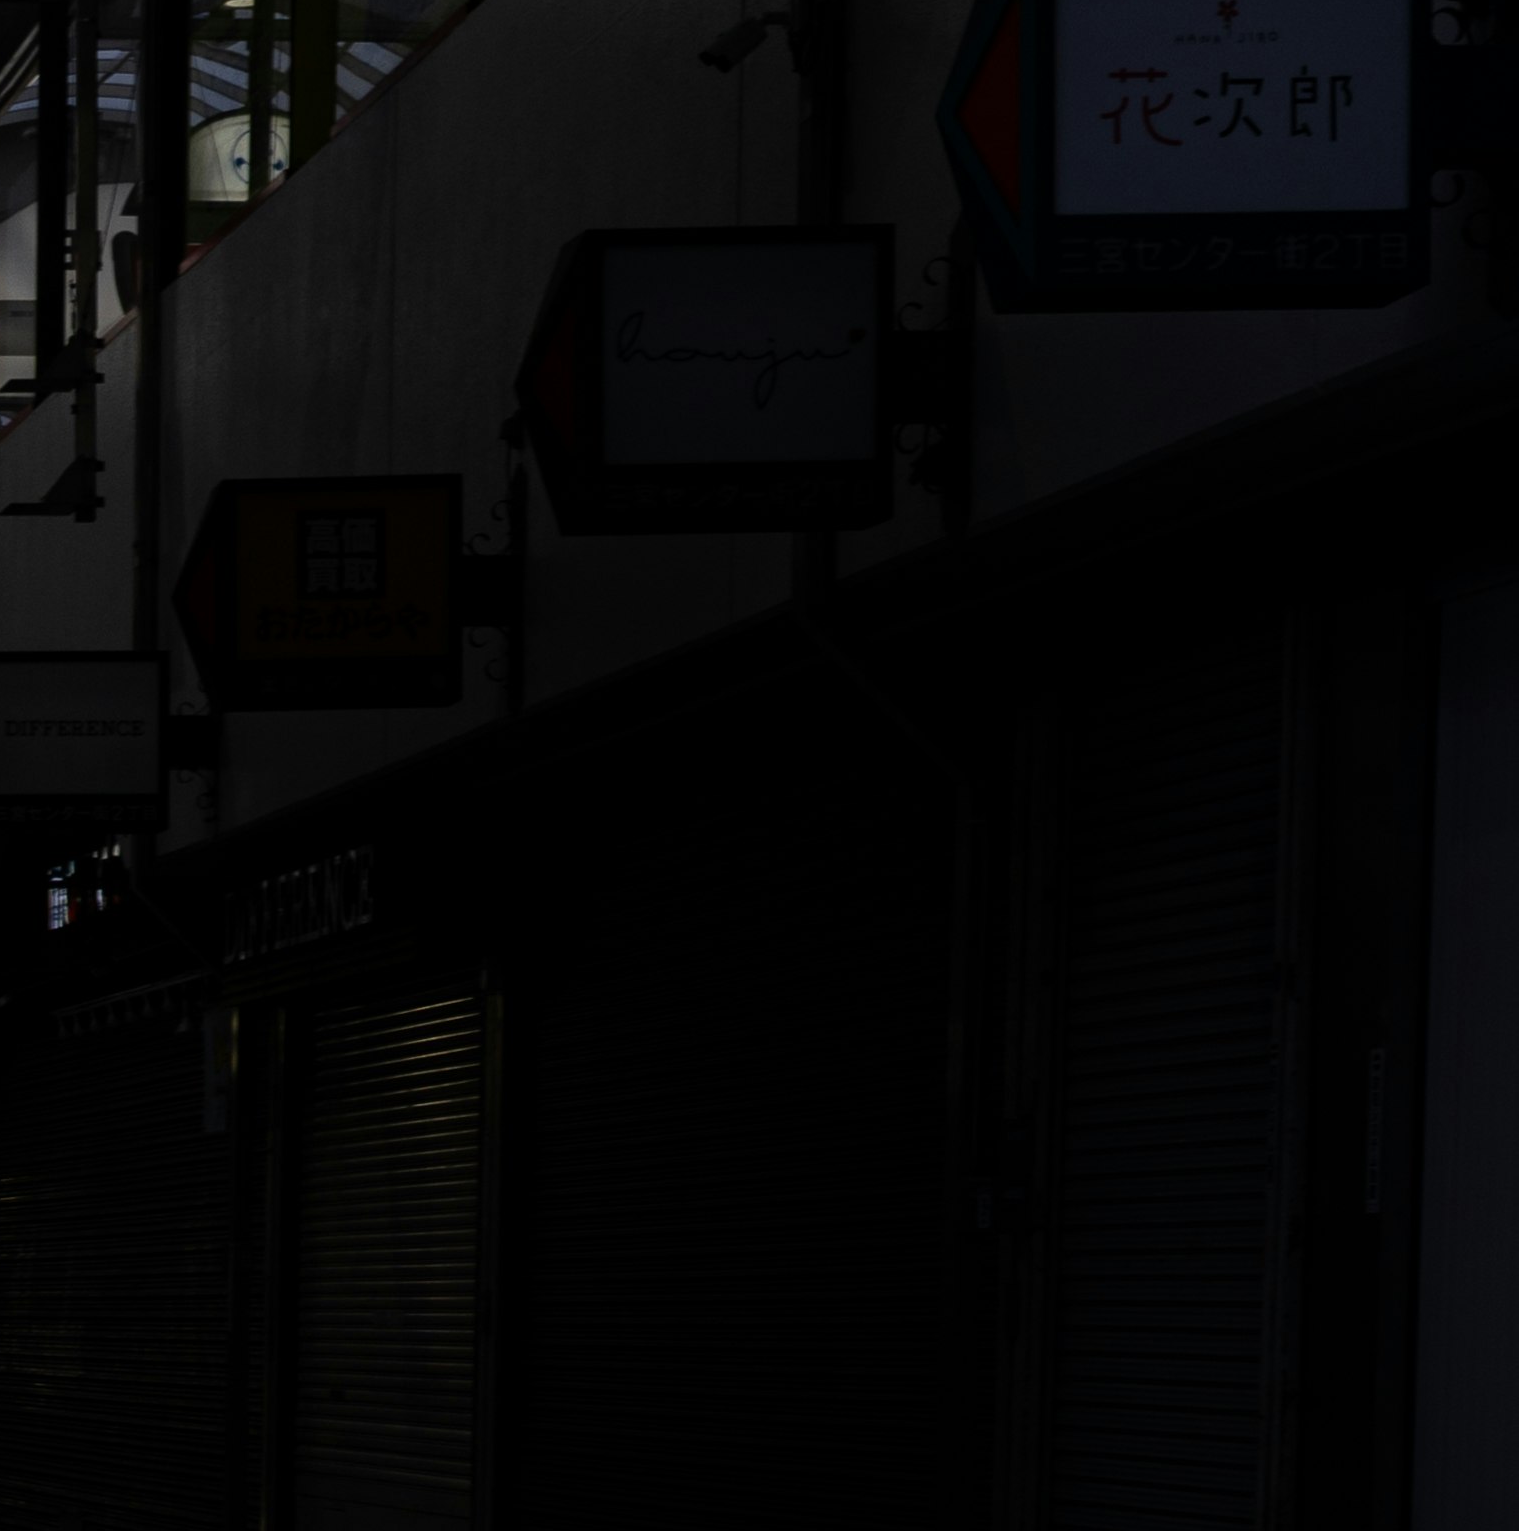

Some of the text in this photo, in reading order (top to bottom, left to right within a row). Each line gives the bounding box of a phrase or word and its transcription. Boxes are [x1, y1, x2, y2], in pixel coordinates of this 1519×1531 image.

[1099, 64, 1354, 146] 花次郎
[1059, 231, 1410, 278] 三宮センター街2丁目
[304, 516, 378, 555] 高価
[304, 557, 378, 594] 買取
[256, 603, 431, 642] おたからや
[4, 719, 146, 737] DIFFERENCE
